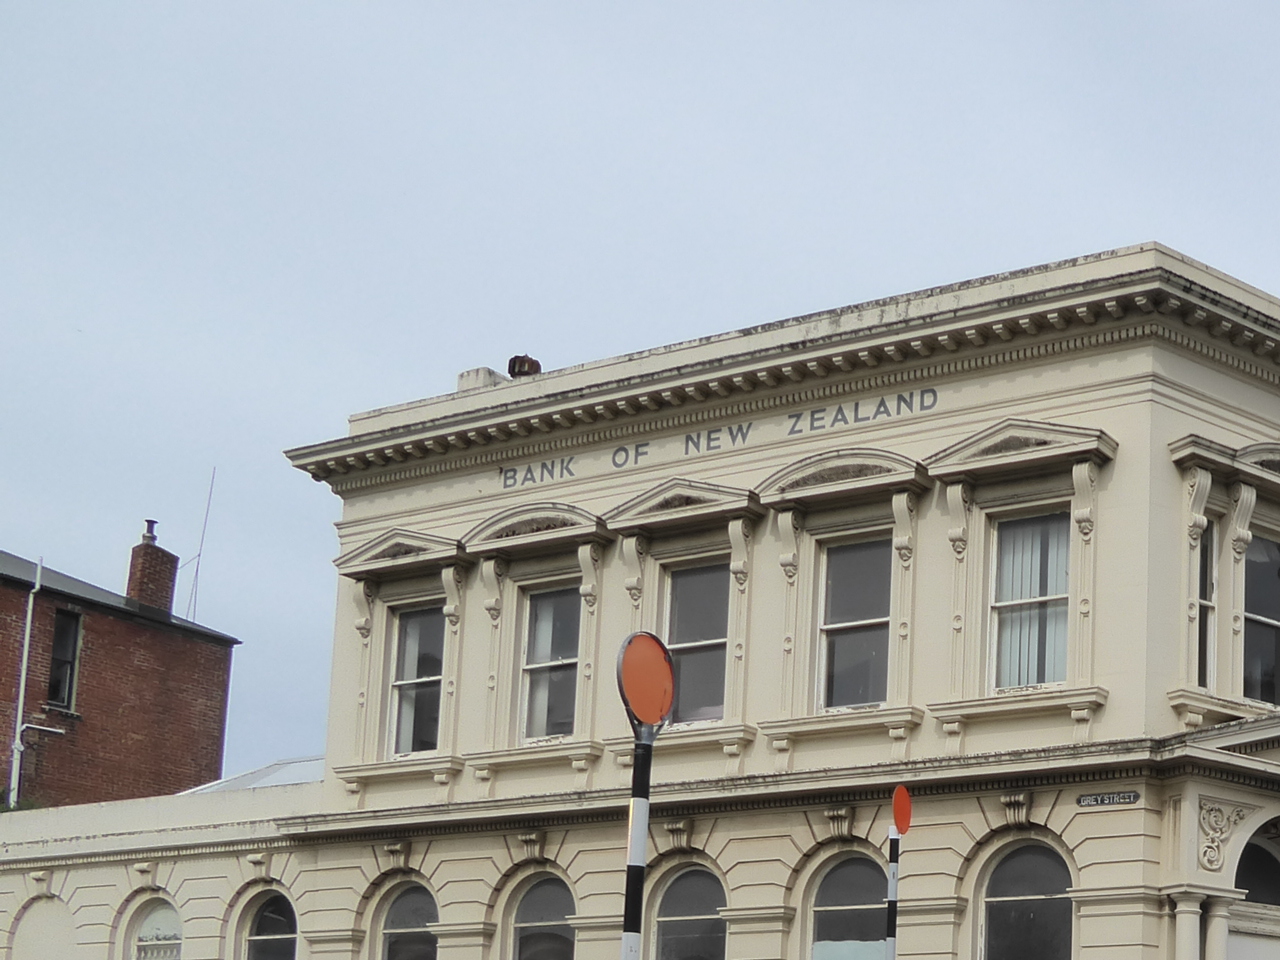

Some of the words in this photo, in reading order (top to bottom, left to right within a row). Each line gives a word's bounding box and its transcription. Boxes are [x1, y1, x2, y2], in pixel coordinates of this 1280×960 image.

[502, 456, 576, 489] BANK
[611, 442, 650, 469] OF
[684, 422, 753, 456] NEW
[787, 388, 939, 436] ZEALAND
[1081, 795, 1102, 805] GREY
[1104, 793, 1135, 803] STREET
